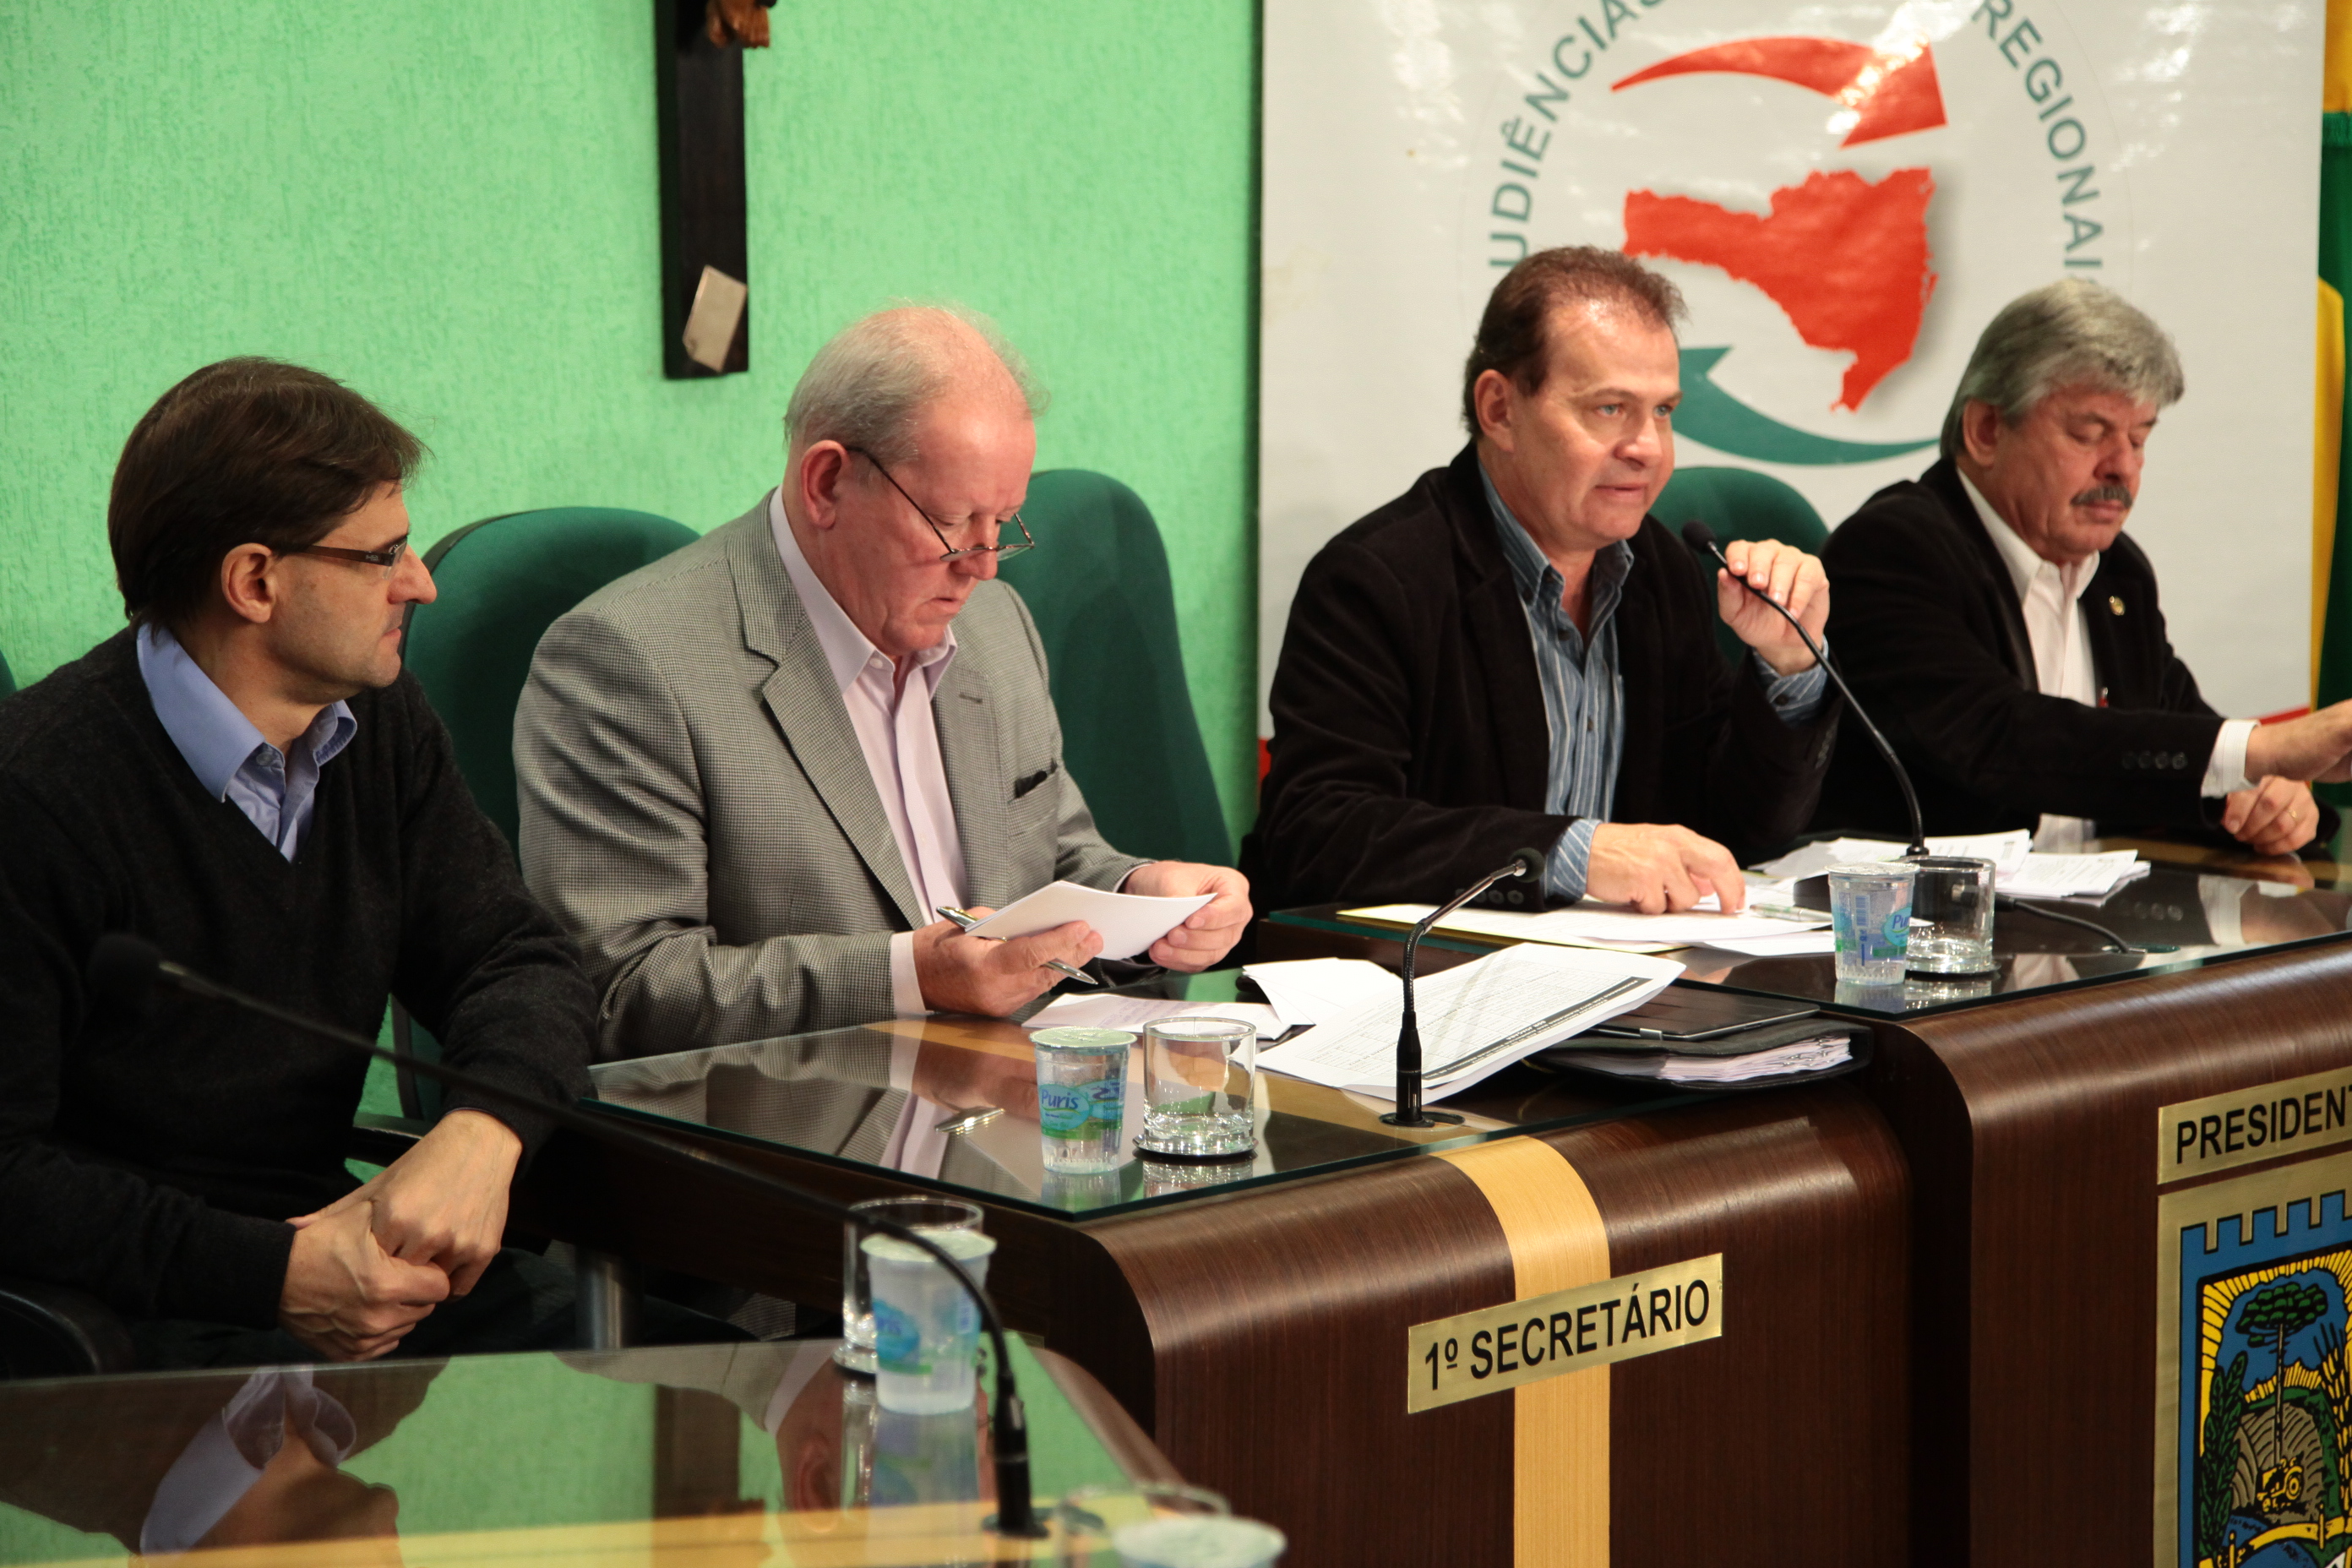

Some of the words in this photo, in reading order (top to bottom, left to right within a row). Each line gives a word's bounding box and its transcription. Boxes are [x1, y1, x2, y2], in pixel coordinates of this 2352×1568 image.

[1489, 0, 1664, 268] UDIÊNCIA
[1971, 0, 2104, 284] REGIONAI
[1041, 1088, 1080, 1110] Puris
[2176, 1084, 2352, 1164] PRESIDEN
[1470, 1279, 1710, 1380] SECRETÁRIO
